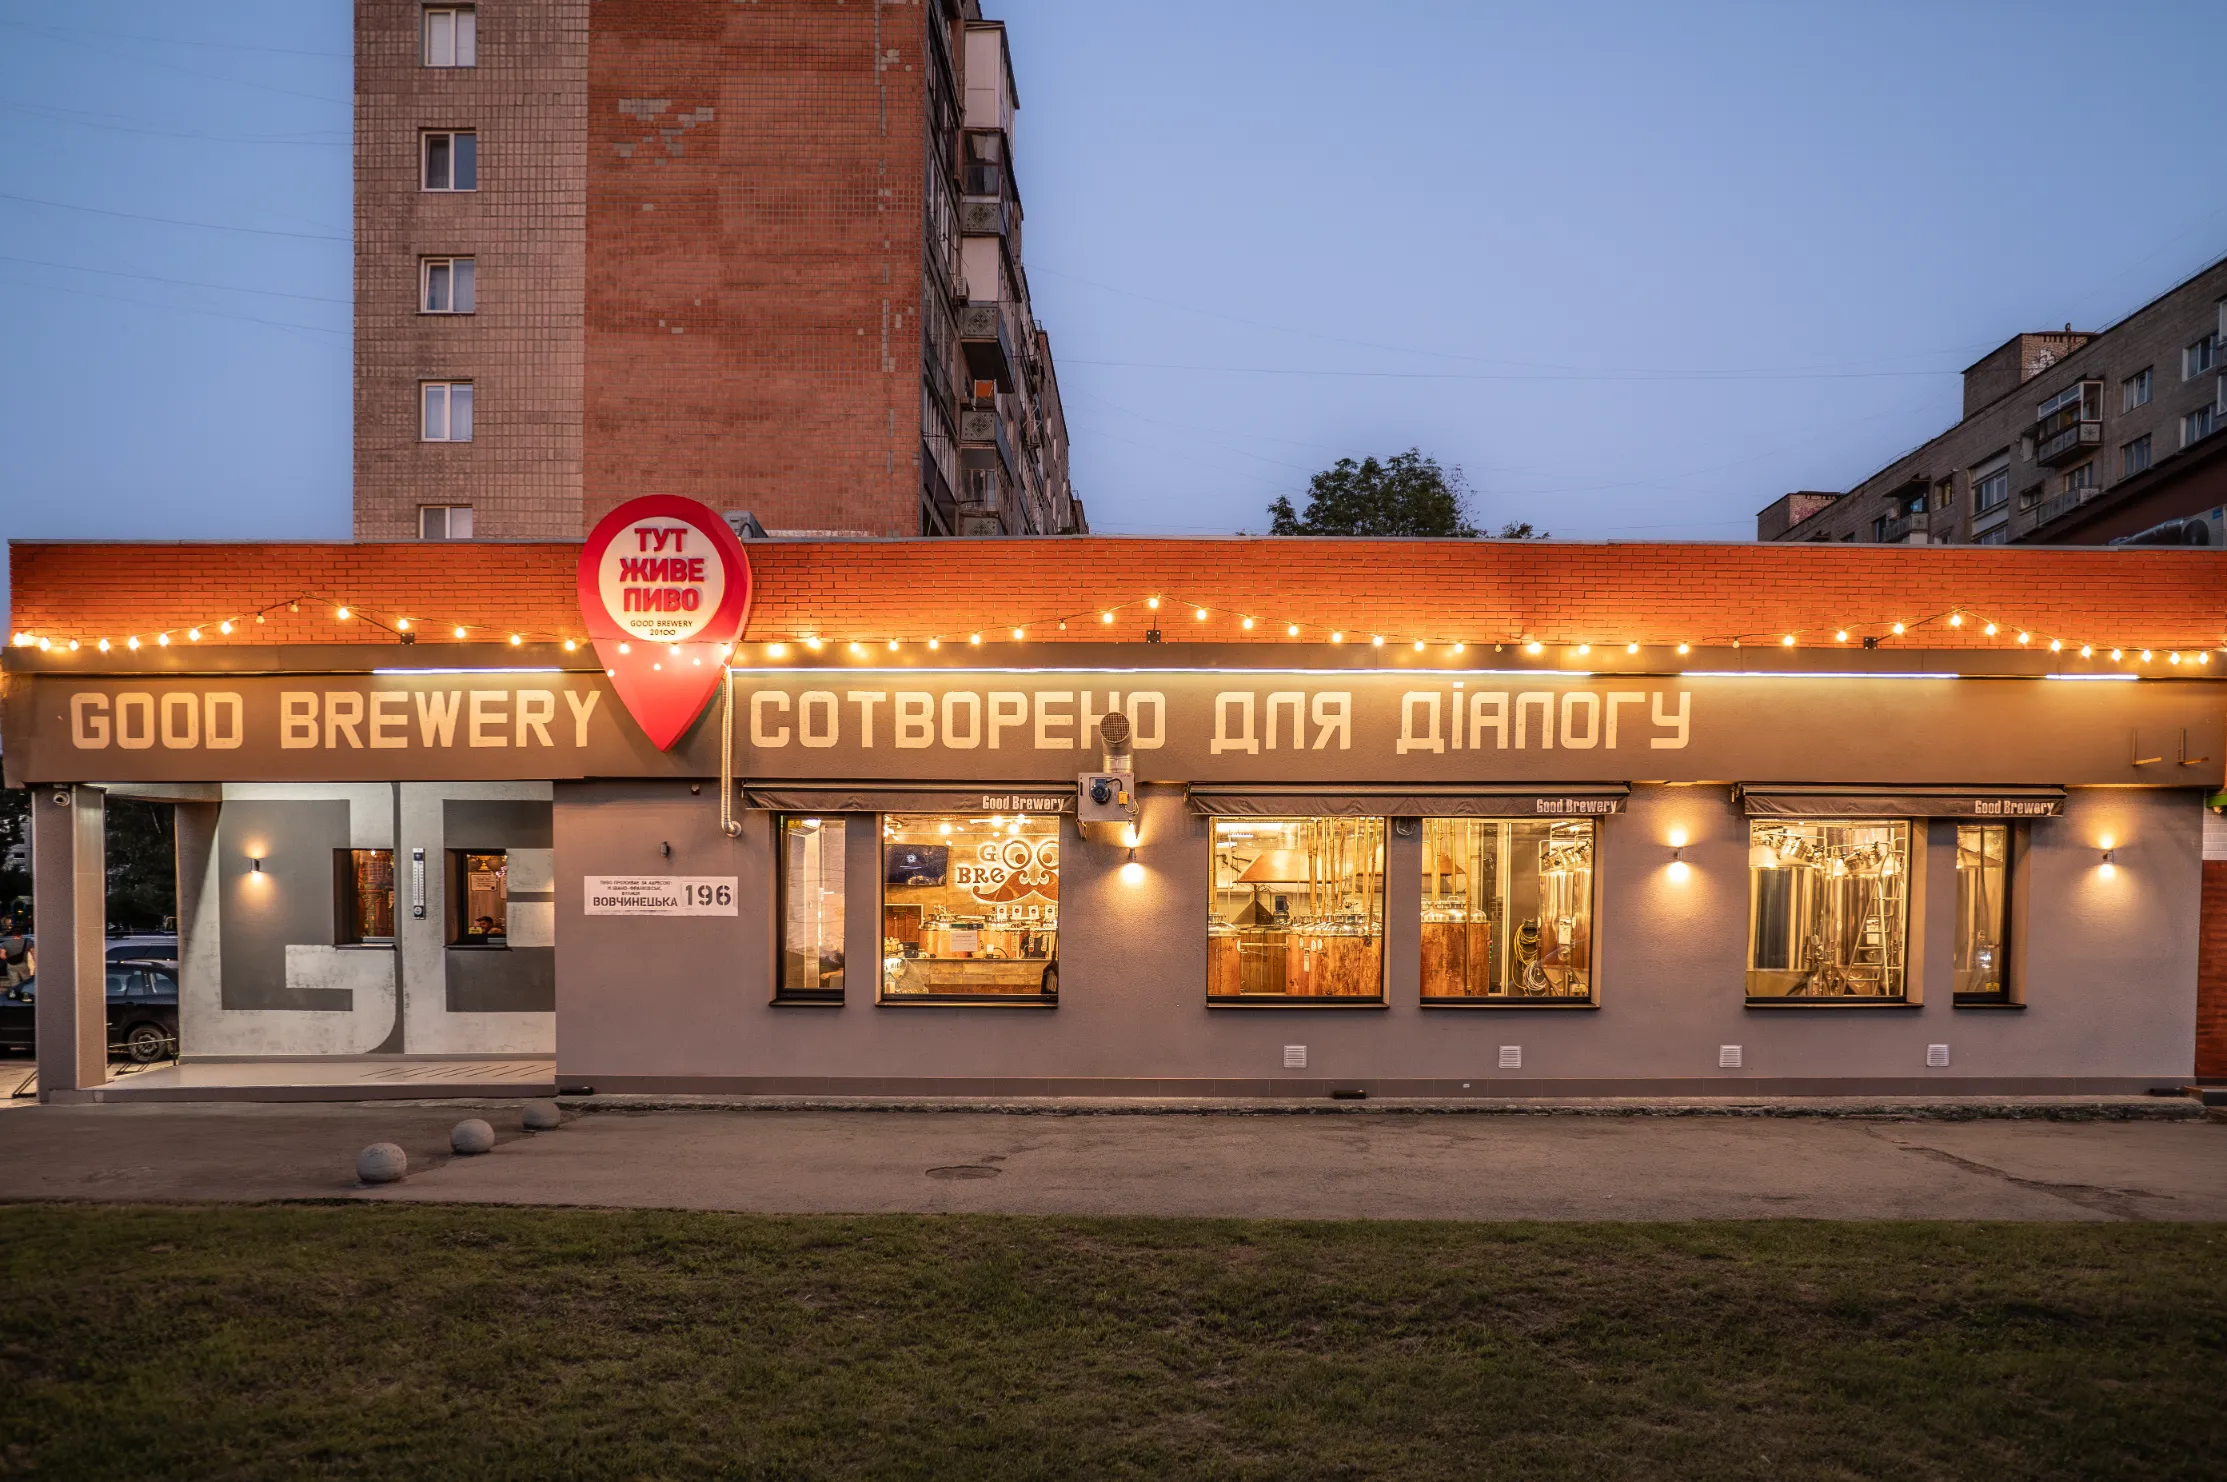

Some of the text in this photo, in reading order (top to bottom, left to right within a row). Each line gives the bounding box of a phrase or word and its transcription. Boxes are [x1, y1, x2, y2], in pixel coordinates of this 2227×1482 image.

[634, 528, 688, 552] ТУТ
[619, 558, 705, 583] ЖИВЕ
[623, 588, 700, 612] ПИВО
[70, 690, 602, 750] GOOD BREWERY
[750, 690, 1166, 750] СОТВОРЕНО
[982, 795, 1065, 812] Good Brewery
[1536, 798, 1618, 814] Good Brewery
[1974, 799, 2055, 816] Good Brewery
[593, 885, 732, 907] ВОВЧИНЕЦЬКА 196
